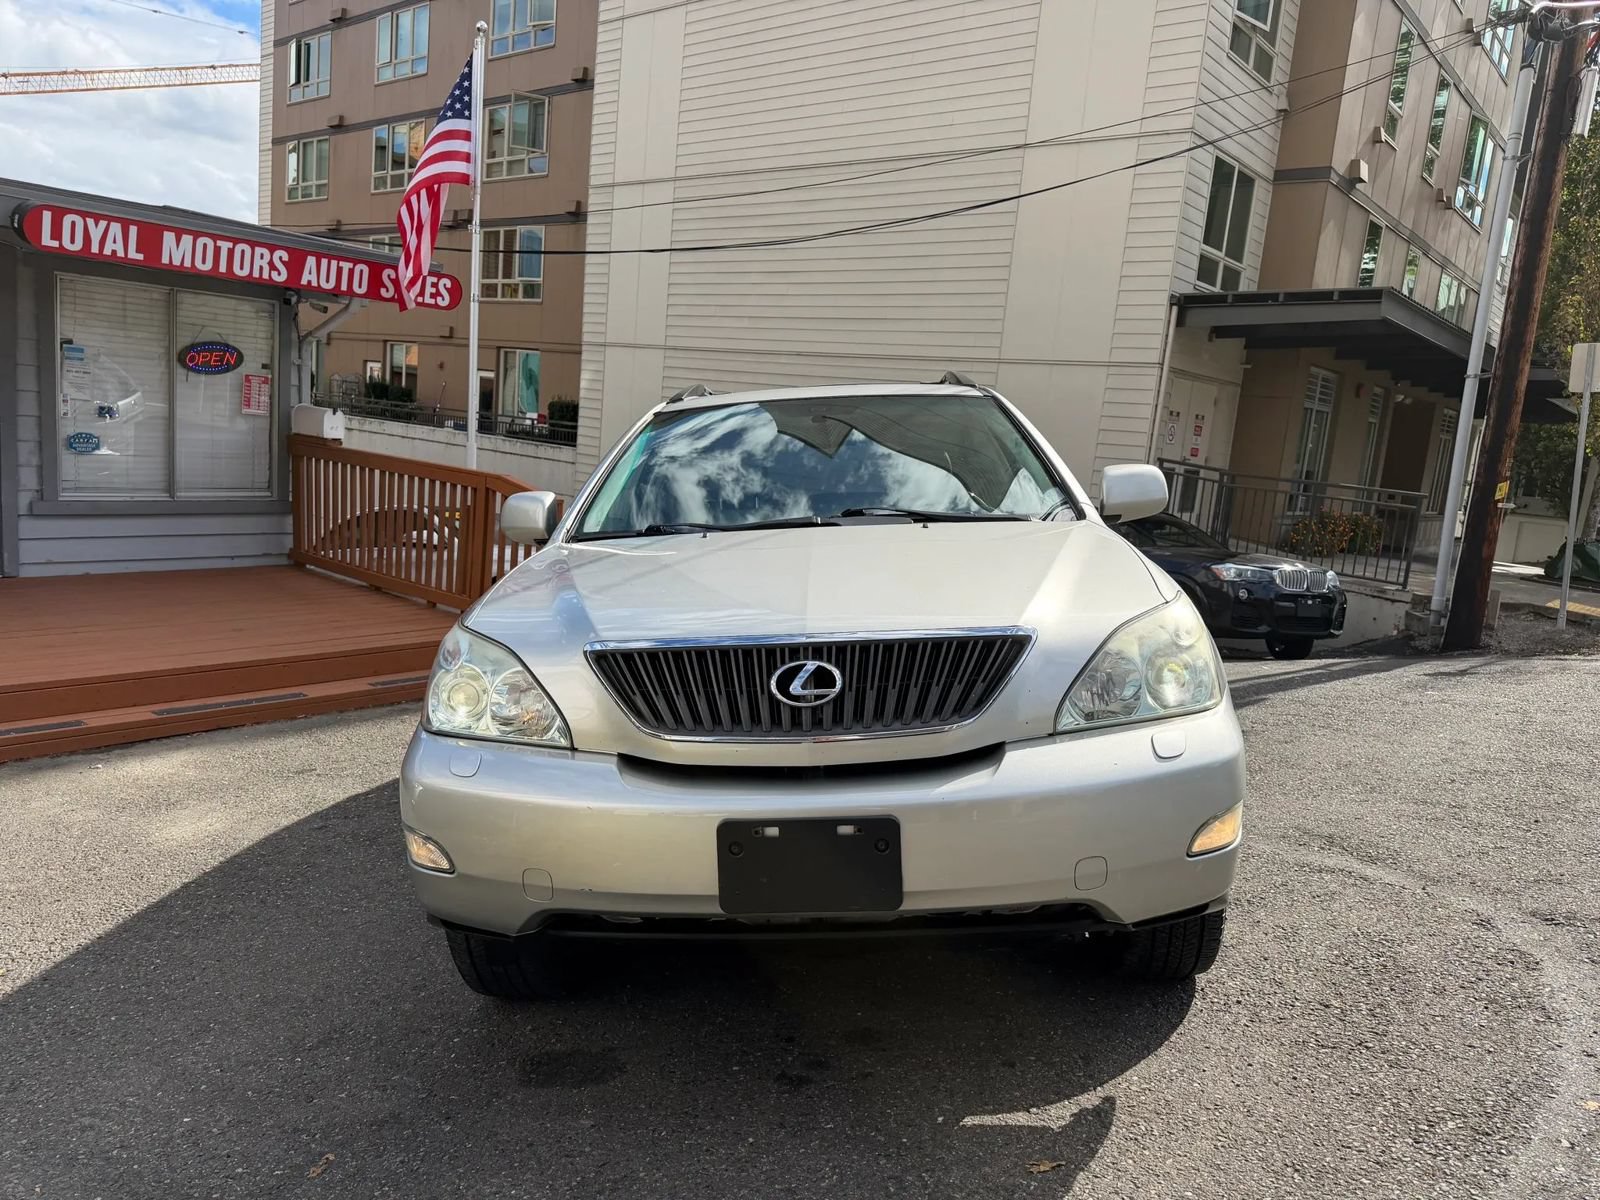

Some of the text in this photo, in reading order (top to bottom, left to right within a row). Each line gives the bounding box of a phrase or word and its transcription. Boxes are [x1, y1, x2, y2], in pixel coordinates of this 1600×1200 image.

[41, 210, 451, 307] LOYAL MOTORS AUTO SES
[186, 352, 237, 367] OPEN
